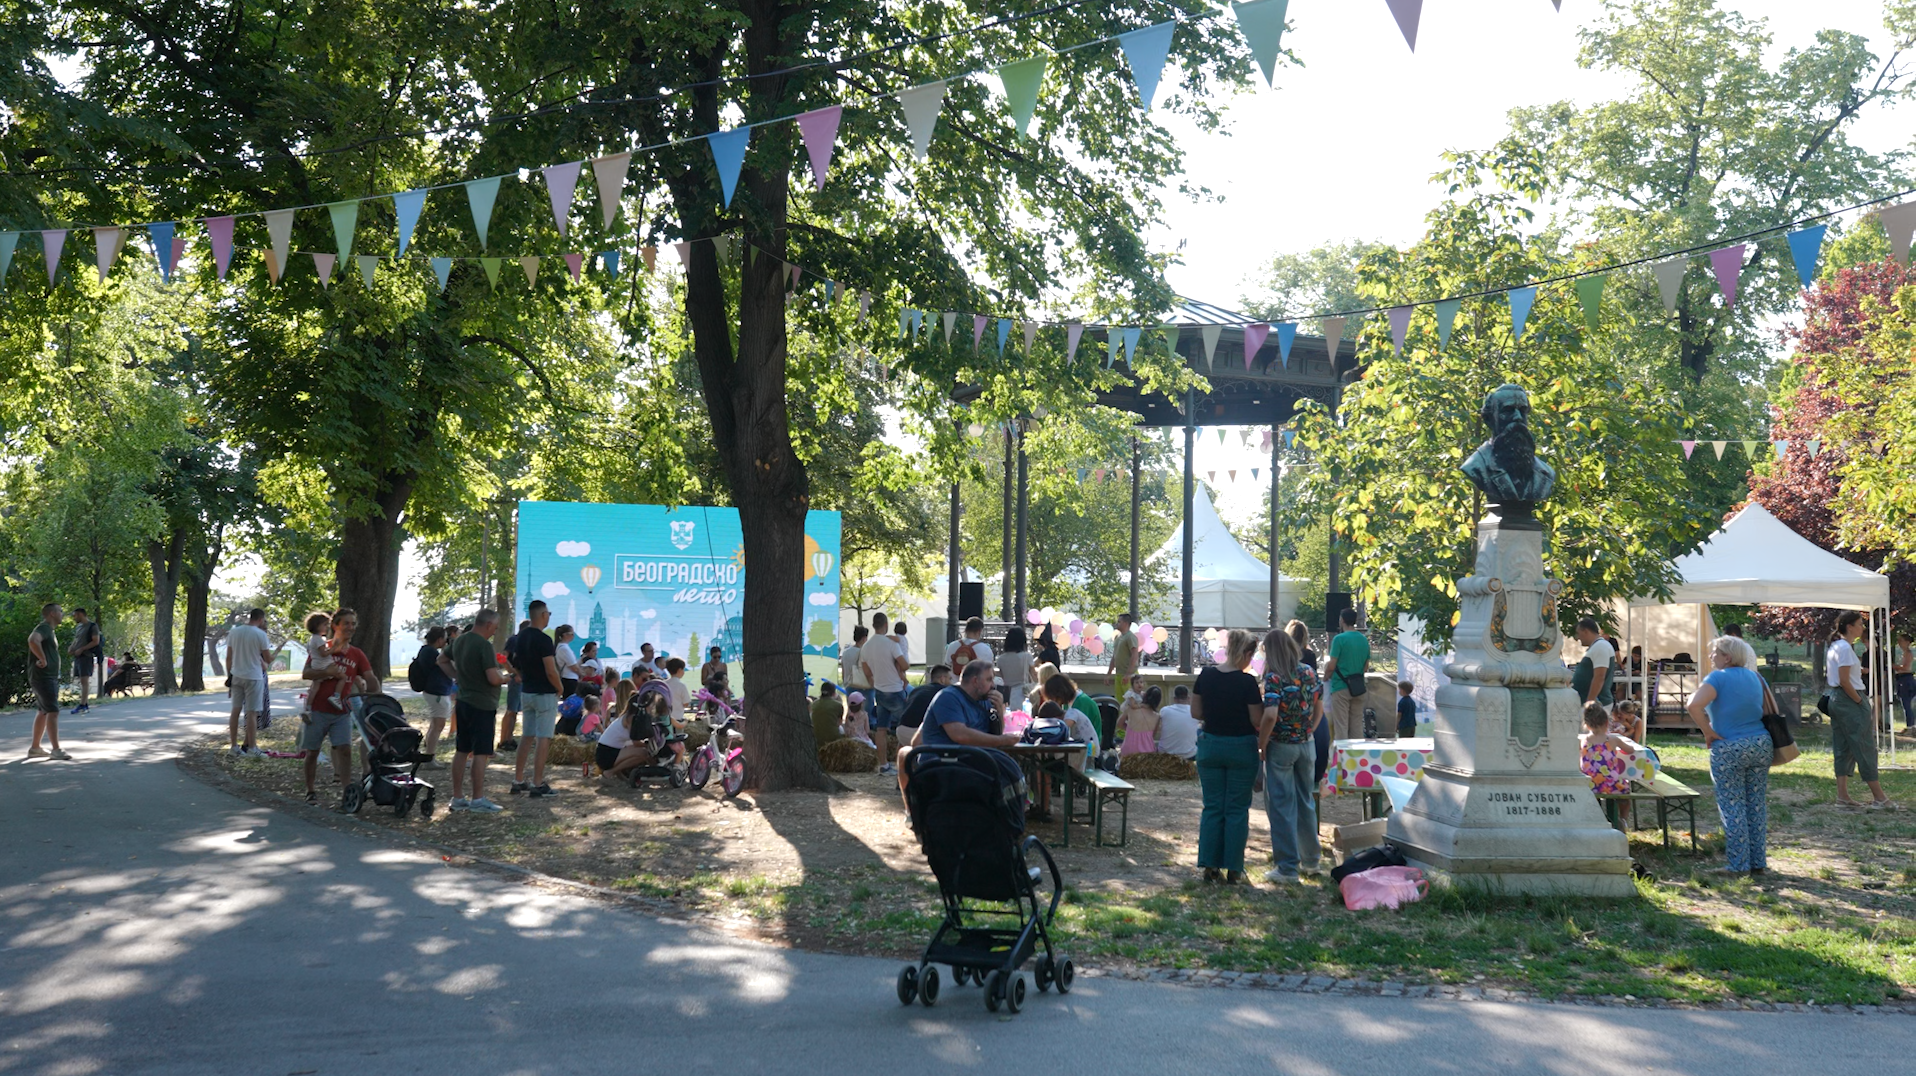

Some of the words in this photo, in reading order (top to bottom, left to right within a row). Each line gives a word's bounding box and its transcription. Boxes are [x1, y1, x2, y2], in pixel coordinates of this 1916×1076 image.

[1487, 792, 1522, 803] ЈОВАН
[1527, 793, 1576, 803] СУБОТИЋ
[1506, 806, 1561, 816] 1817-1886
